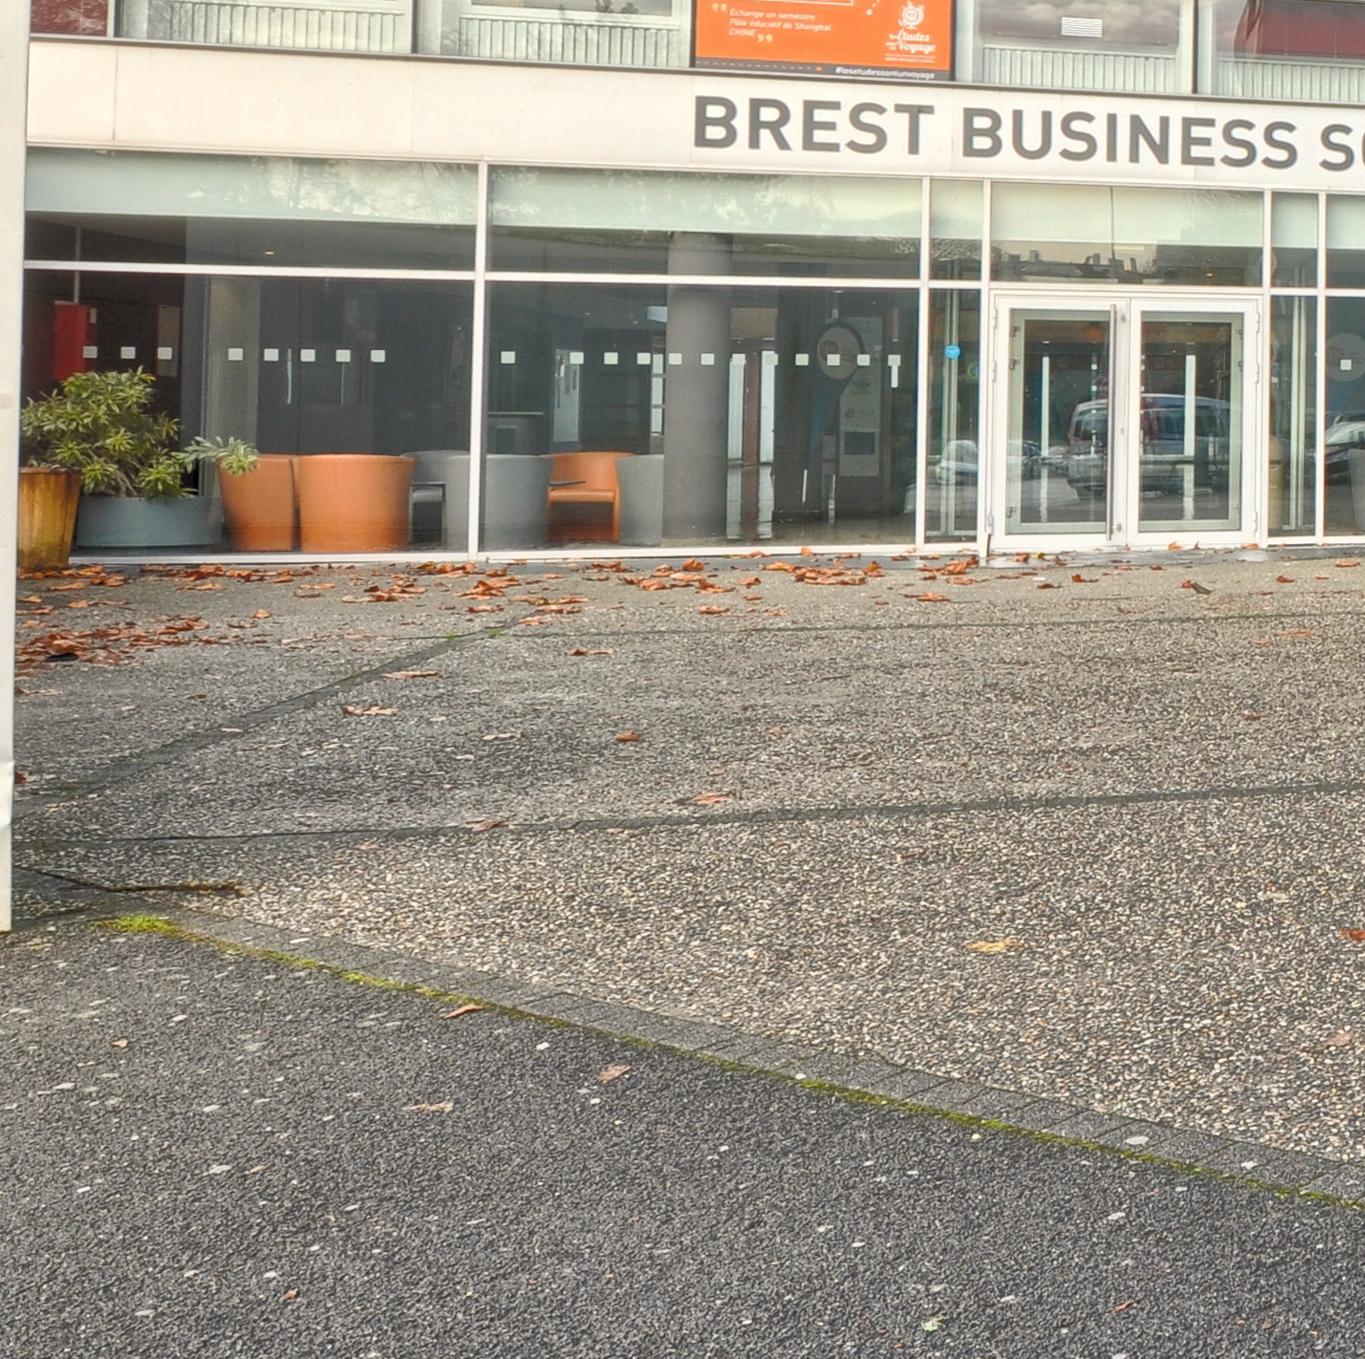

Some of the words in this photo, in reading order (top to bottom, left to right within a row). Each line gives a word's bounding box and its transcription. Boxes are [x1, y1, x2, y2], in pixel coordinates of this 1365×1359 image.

[778, 12, 817, 21] semestre
[729, 28, 756, 37] CHINE
[782, 22, 793, 30] de
[794, 23, 832, 33] Shanghai
[694, 95, 935, 155] BREST
[962, 107, 1298, 170] BUSINESS
